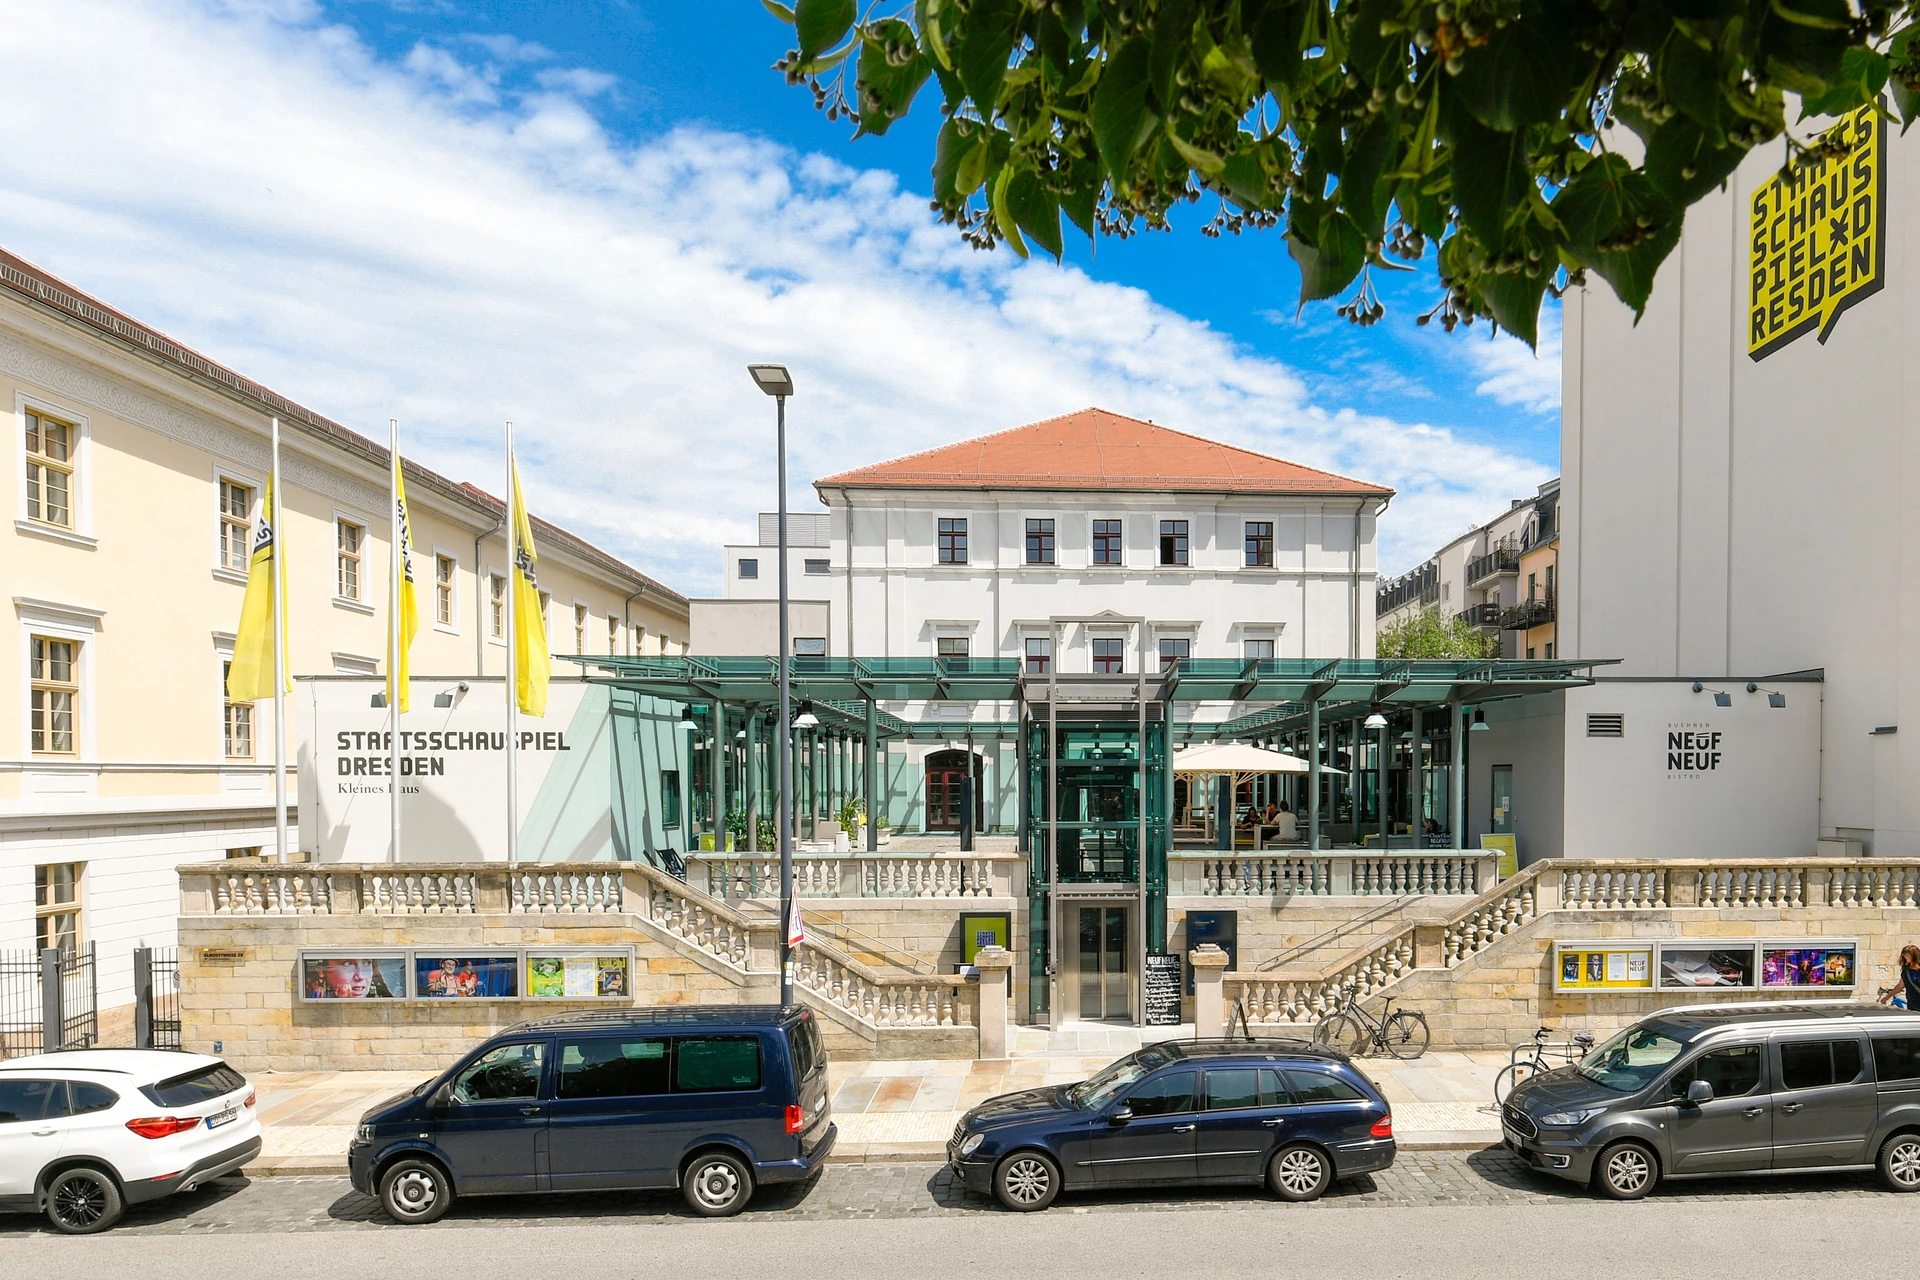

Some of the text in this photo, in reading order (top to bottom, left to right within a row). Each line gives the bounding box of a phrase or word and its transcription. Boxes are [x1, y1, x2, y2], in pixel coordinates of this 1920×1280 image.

[1753, 147, 1872, 269] SCHAUS
[1751, 235, 1871, 345] RESDEN
[337, 731, 571, 751] STAATSSCHAUPIEL
[1667, 732, 1722, 750] NEUF
[1667, 752, 1722, 770] NEUF
[337, 783, 384, 794] Kleines
